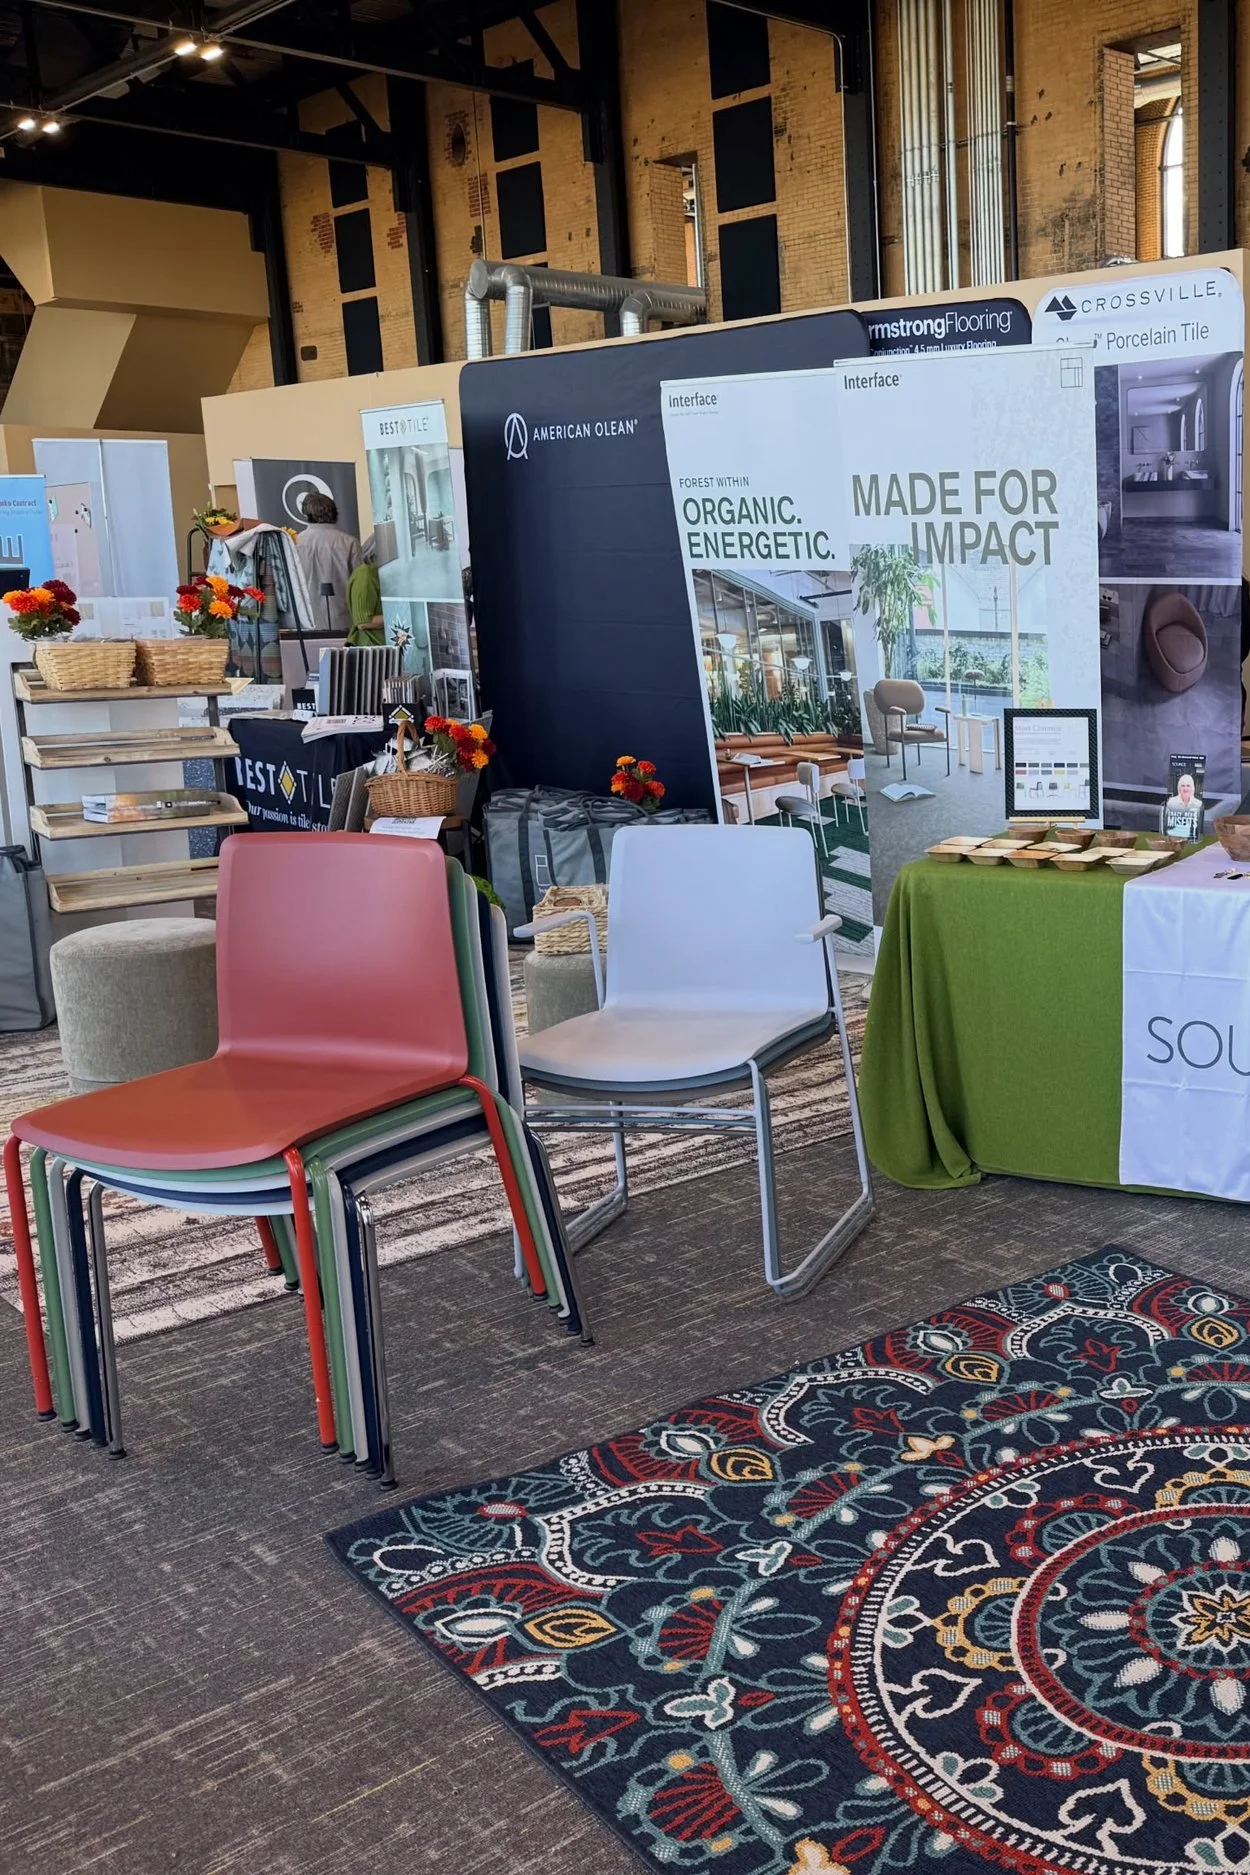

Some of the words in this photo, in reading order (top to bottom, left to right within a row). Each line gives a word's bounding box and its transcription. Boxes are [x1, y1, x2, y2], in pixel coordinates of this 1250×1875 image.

[867, 308, 1012, 340] rmstrongFlooring
[1107, 327, 1177, 351] Porcelain
[1181, 321, 1210, 342] Tile
[843, 371, 900, 390] Interface
[668, 391, 718, 408] Interface
[379, 420, 400, 436] BEST
[533, 423, 592, 442] AMERICAN
[679, 477, 714, 489] FOREST
[716, 476, 750, 488] WITHIN
[851, 471, 963, 517] MADE
[974, 468, 1059, 516] FOR
[682, 495, 803, 526] ORGANIC.
[686, 530, 836, 561] ENERGETIC.
[910, 519, 1060, 567] IMPACT
[296, 701, 317, 711] BEST
[261, 803, 289, 825] passion
